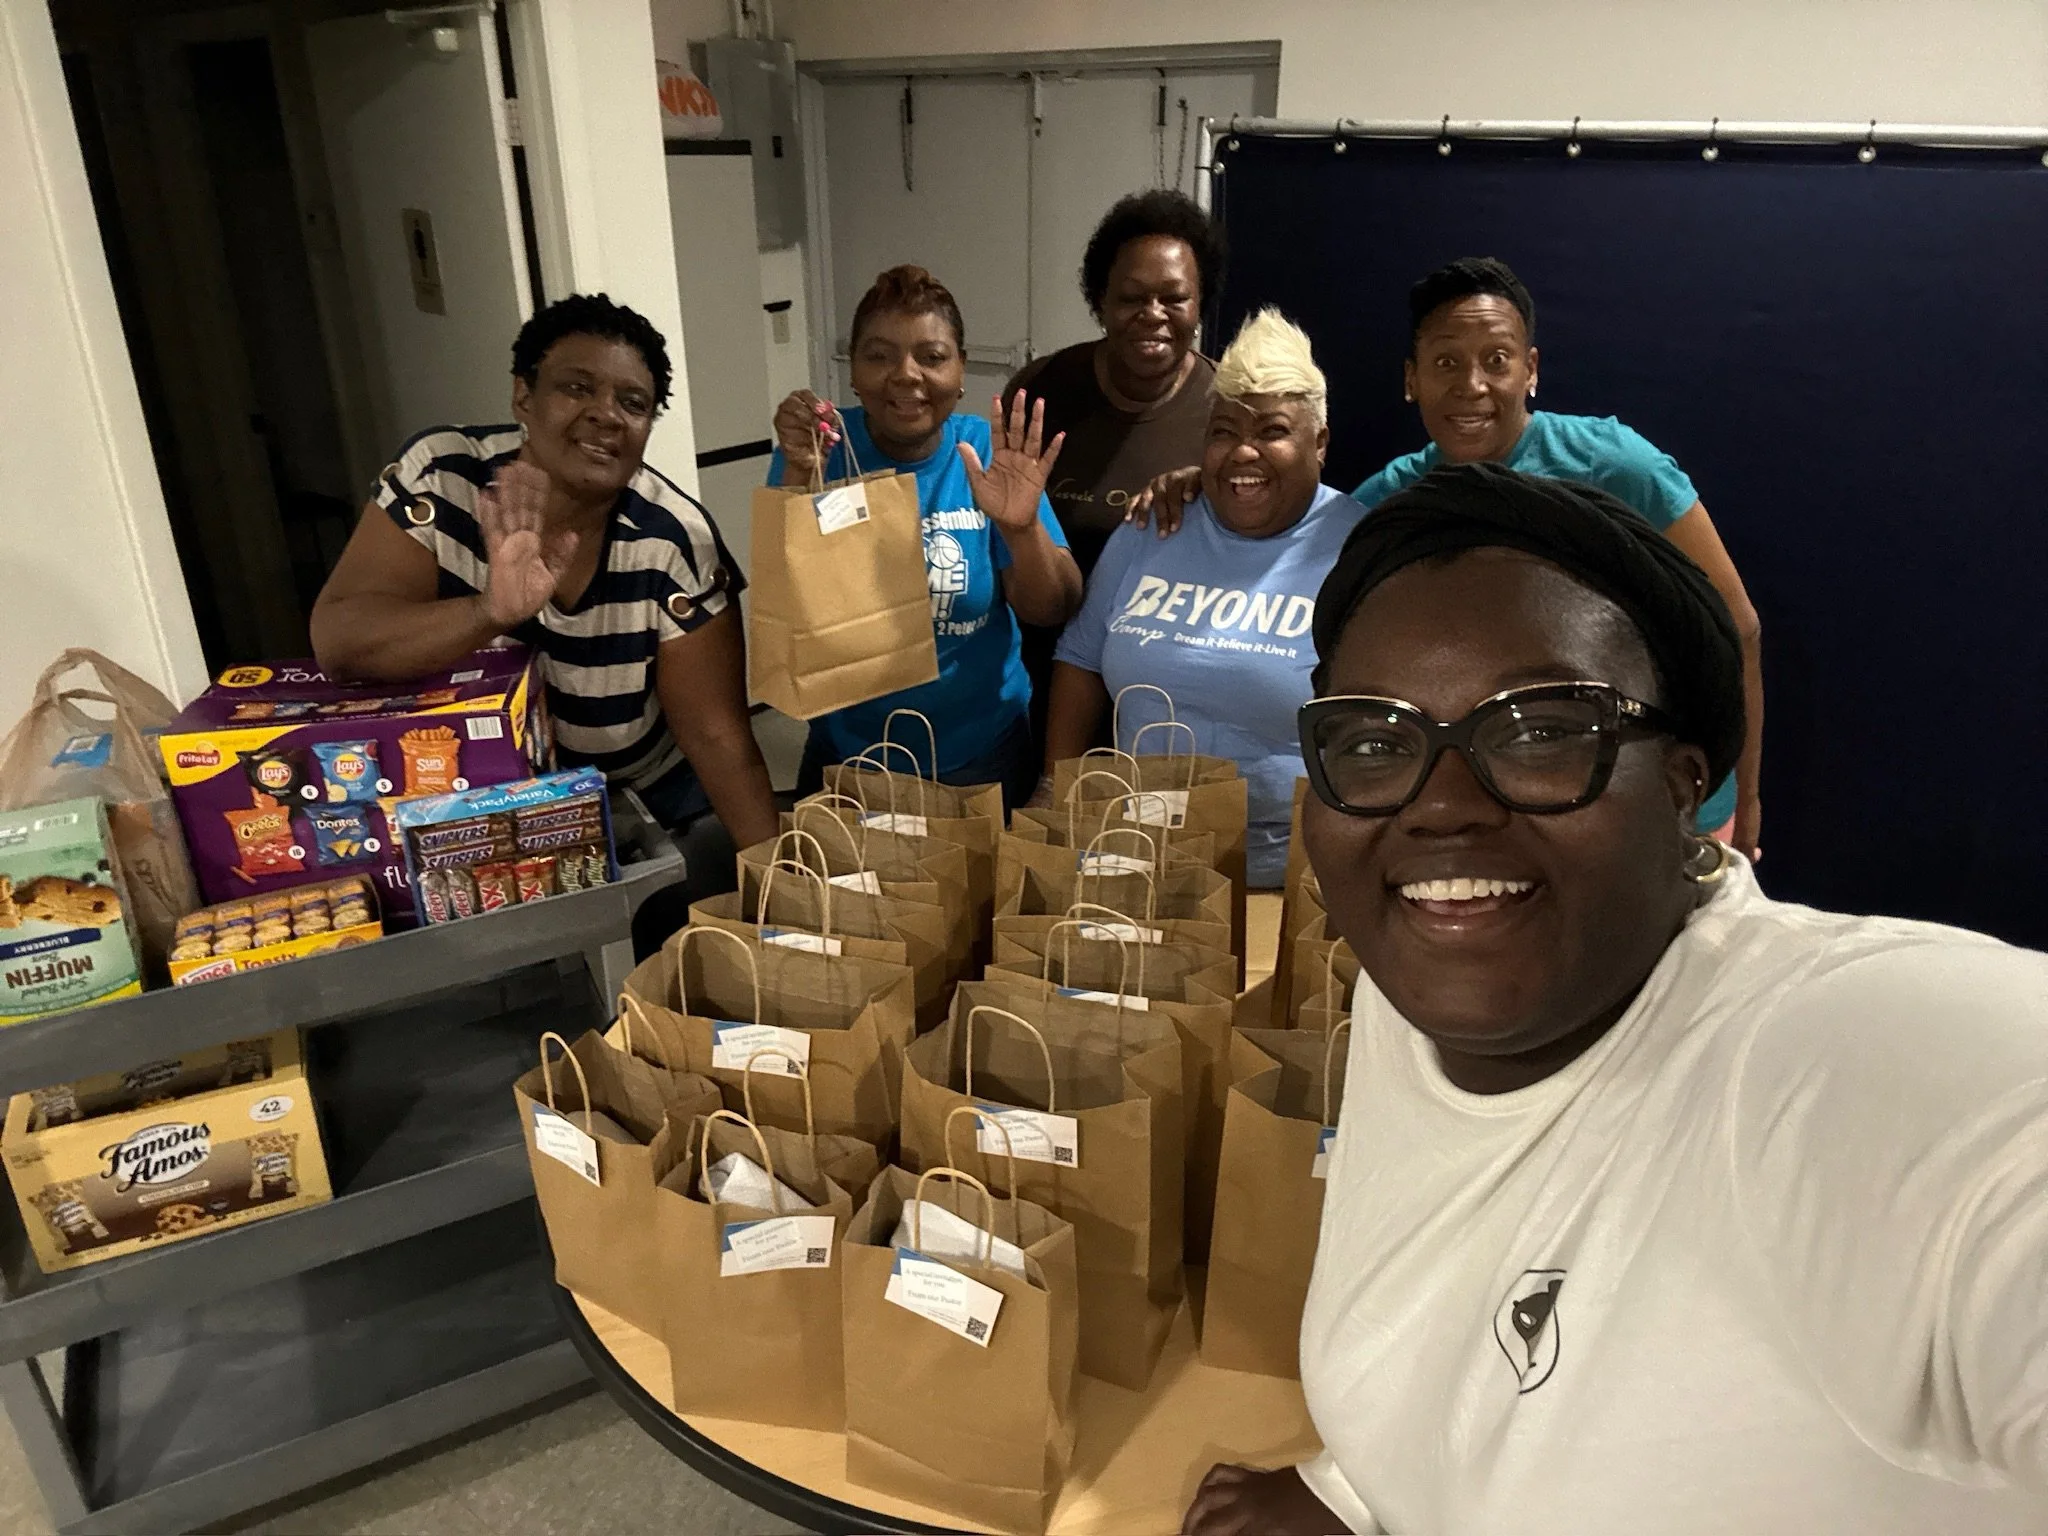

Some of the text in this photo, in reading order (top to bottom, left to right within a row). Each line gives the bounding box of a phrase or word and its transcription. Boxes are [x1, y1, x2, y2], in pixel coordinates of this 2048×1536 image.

[1124, 575, 1315, 639] BEYOND
[937, 621, 945, 636] 2
[1109, 614, 1167, 647] Camp
[1173, 632, 1206, 647] Dream
[1287, 648, 1297, 659] it
[228, 672, 328, 684] 50 vor
[306, 788, 314, 797] 6
[380, 782, 388, 790] 5
[574, 779, 594, 791] 30
[316, 816, 361, 830] Doritos
[421, 827, 487, 847] SNICKERS
[520, 830, 581, 849] SATISFIES
[291, 848, 303, 858] 16
[383, 865, 411, 889] fl
[13, 936, 70, 953] BLUEBERRY
[6, 955, 94, 988] MUFFIN
[259, 1101, 281, 1114] 42
[99, 1122, 212, 1180] Famous
[116, 1146, 206, 1193] Amos
